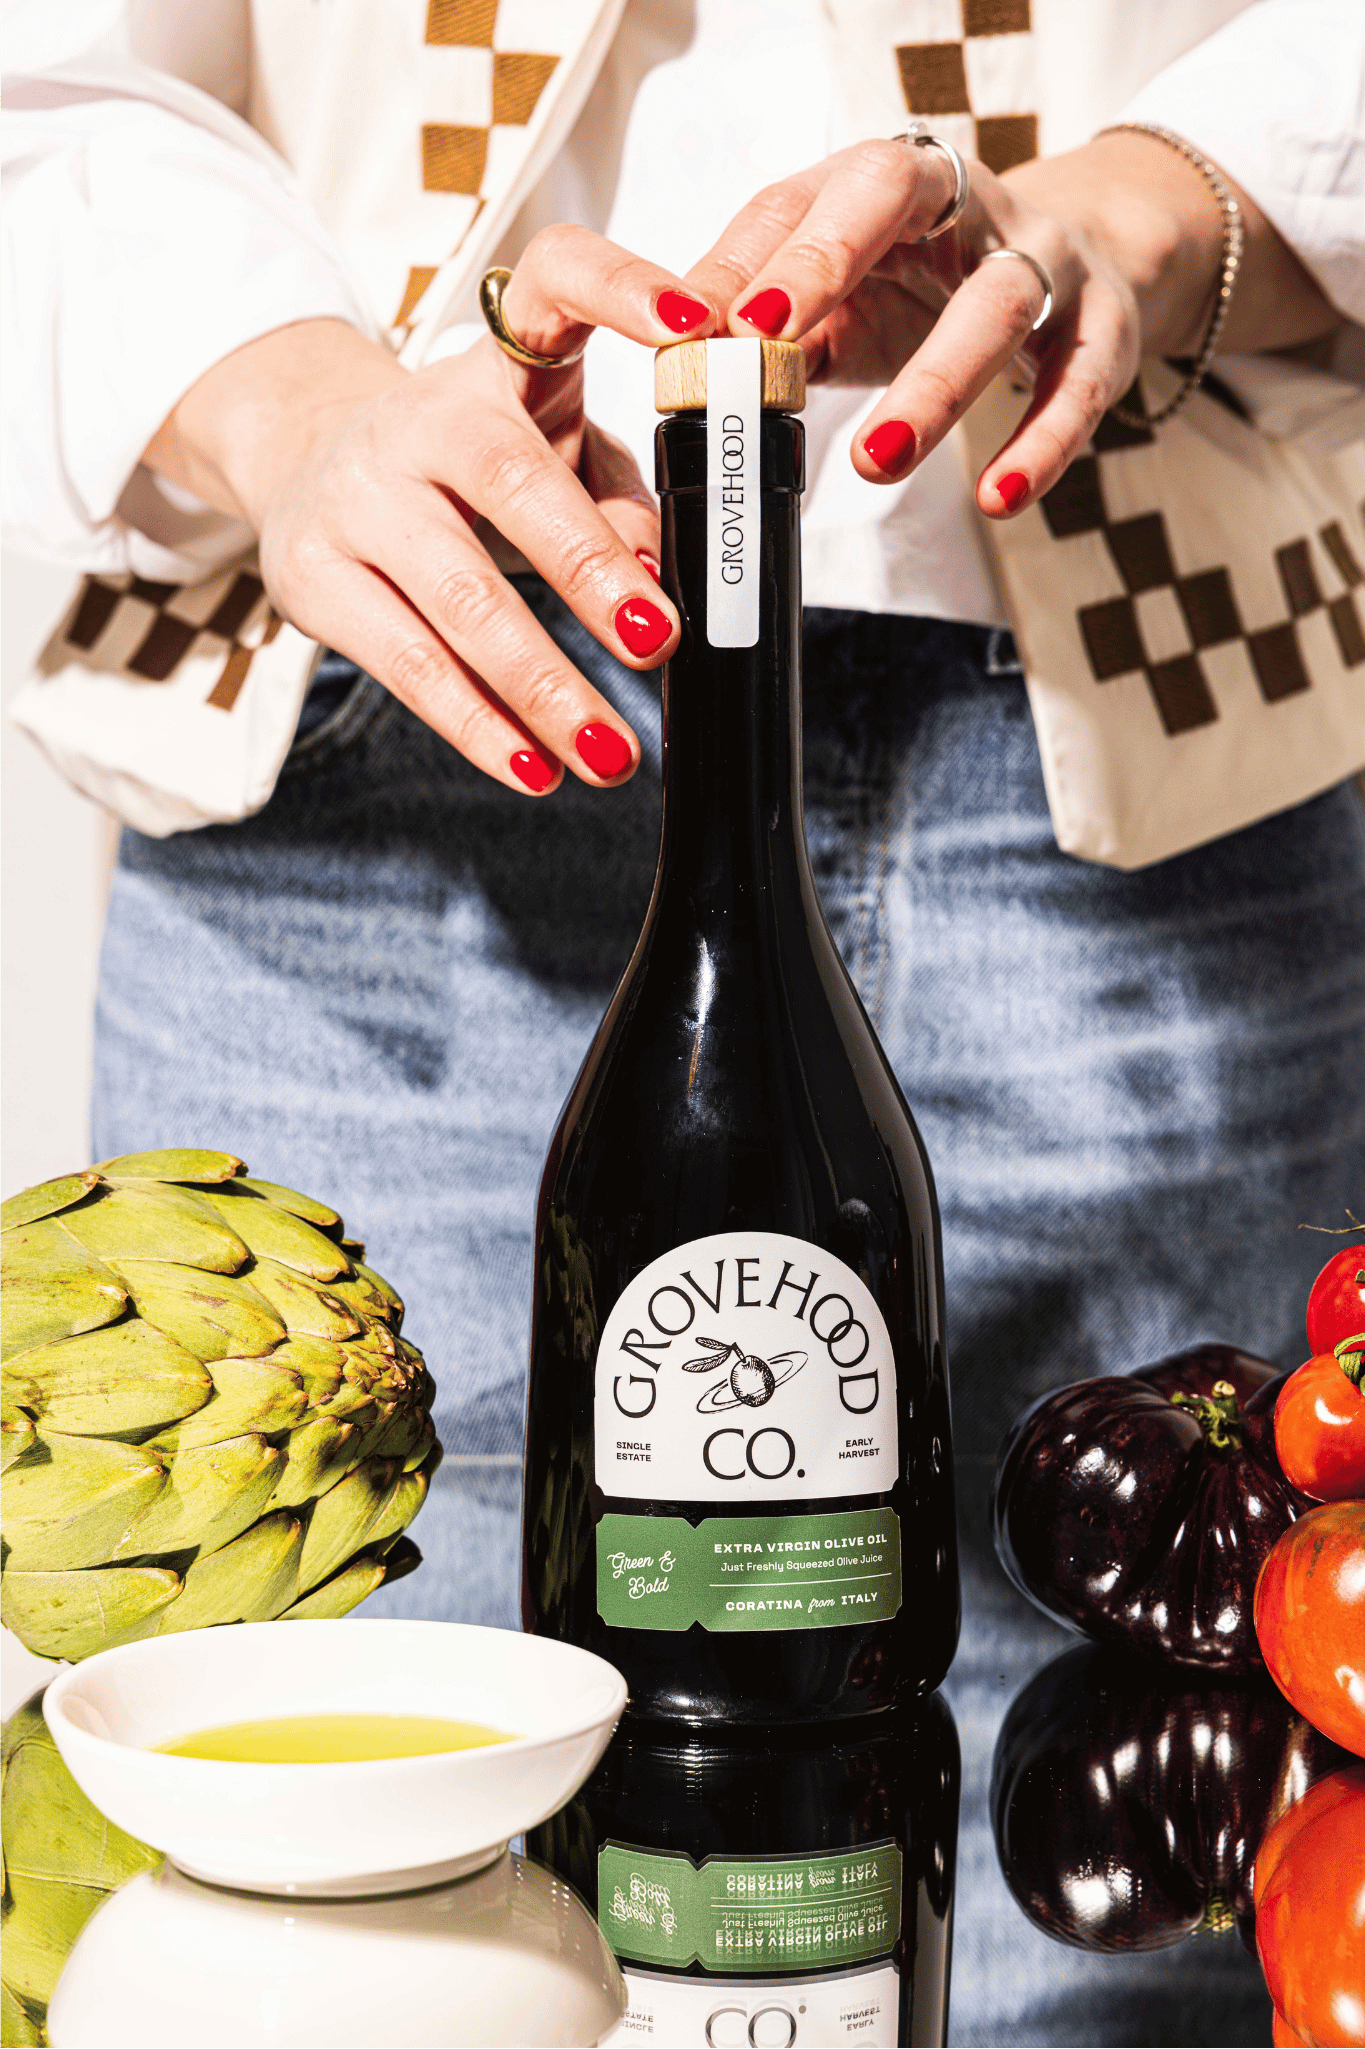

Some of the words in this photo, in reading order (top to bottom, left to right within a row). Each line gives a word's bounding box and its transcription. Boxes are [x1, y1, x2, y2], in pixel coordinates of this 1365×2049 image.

[721, 414, 744, 585] GROVEHOOD
[613, 1258, 880, 1419] GROVEHOOD
[616, 1441, 652, 1451] SINGLE
[845, 1437, 874, 1448] EARLY
[616, 1452, 652, 1462] ESTATE
[703, 1427, 806, 1480] CO.
[838, 1448, 880, 1459] HARVEST
[714, 1543, 763, 1553] EXTRA
[766, 1540, 821, 1553] VIRGIN
[824, 1536, 864, 1549] OLIVE
[867, 1533, 888, 1545] OIL
[606, 1551, 654, 1579] Green
[658, 1550, 676, 1572] &
[720, 1562, 744, 1572] Just
[746, 1561, 784, 1573] Freshly
[786, 1558, 835, 1571] Squeezed
[836, 1556, 859, 1567] Olive
[860, 1553, 883, 1564] Juice
[628, 1576, 670, 1599] Bold
[725, 1599, 803, 1611] CORATINA
[807, 1597, 836, 1614] from
[841, 1592, 878, 1605] ITALY
